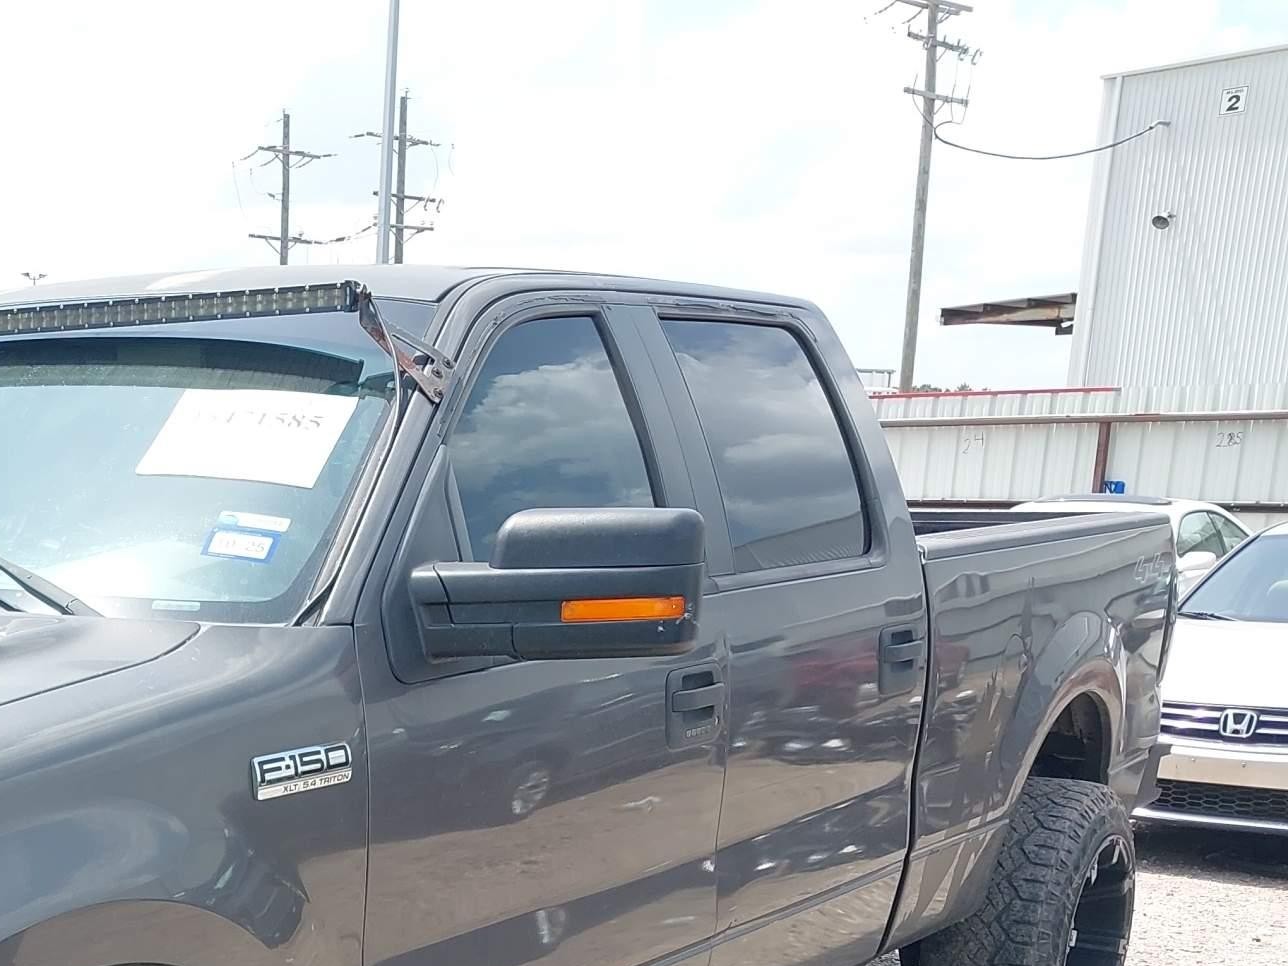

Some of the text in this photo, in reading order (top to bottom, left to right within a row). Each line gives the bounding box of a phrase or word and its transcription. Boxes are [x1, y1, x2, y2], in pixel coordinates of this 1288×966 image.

[1225, 94, 1241, 112] 2
[282, 783, 300, 794] XLT
[319, 772, 351, 786] TRITON
